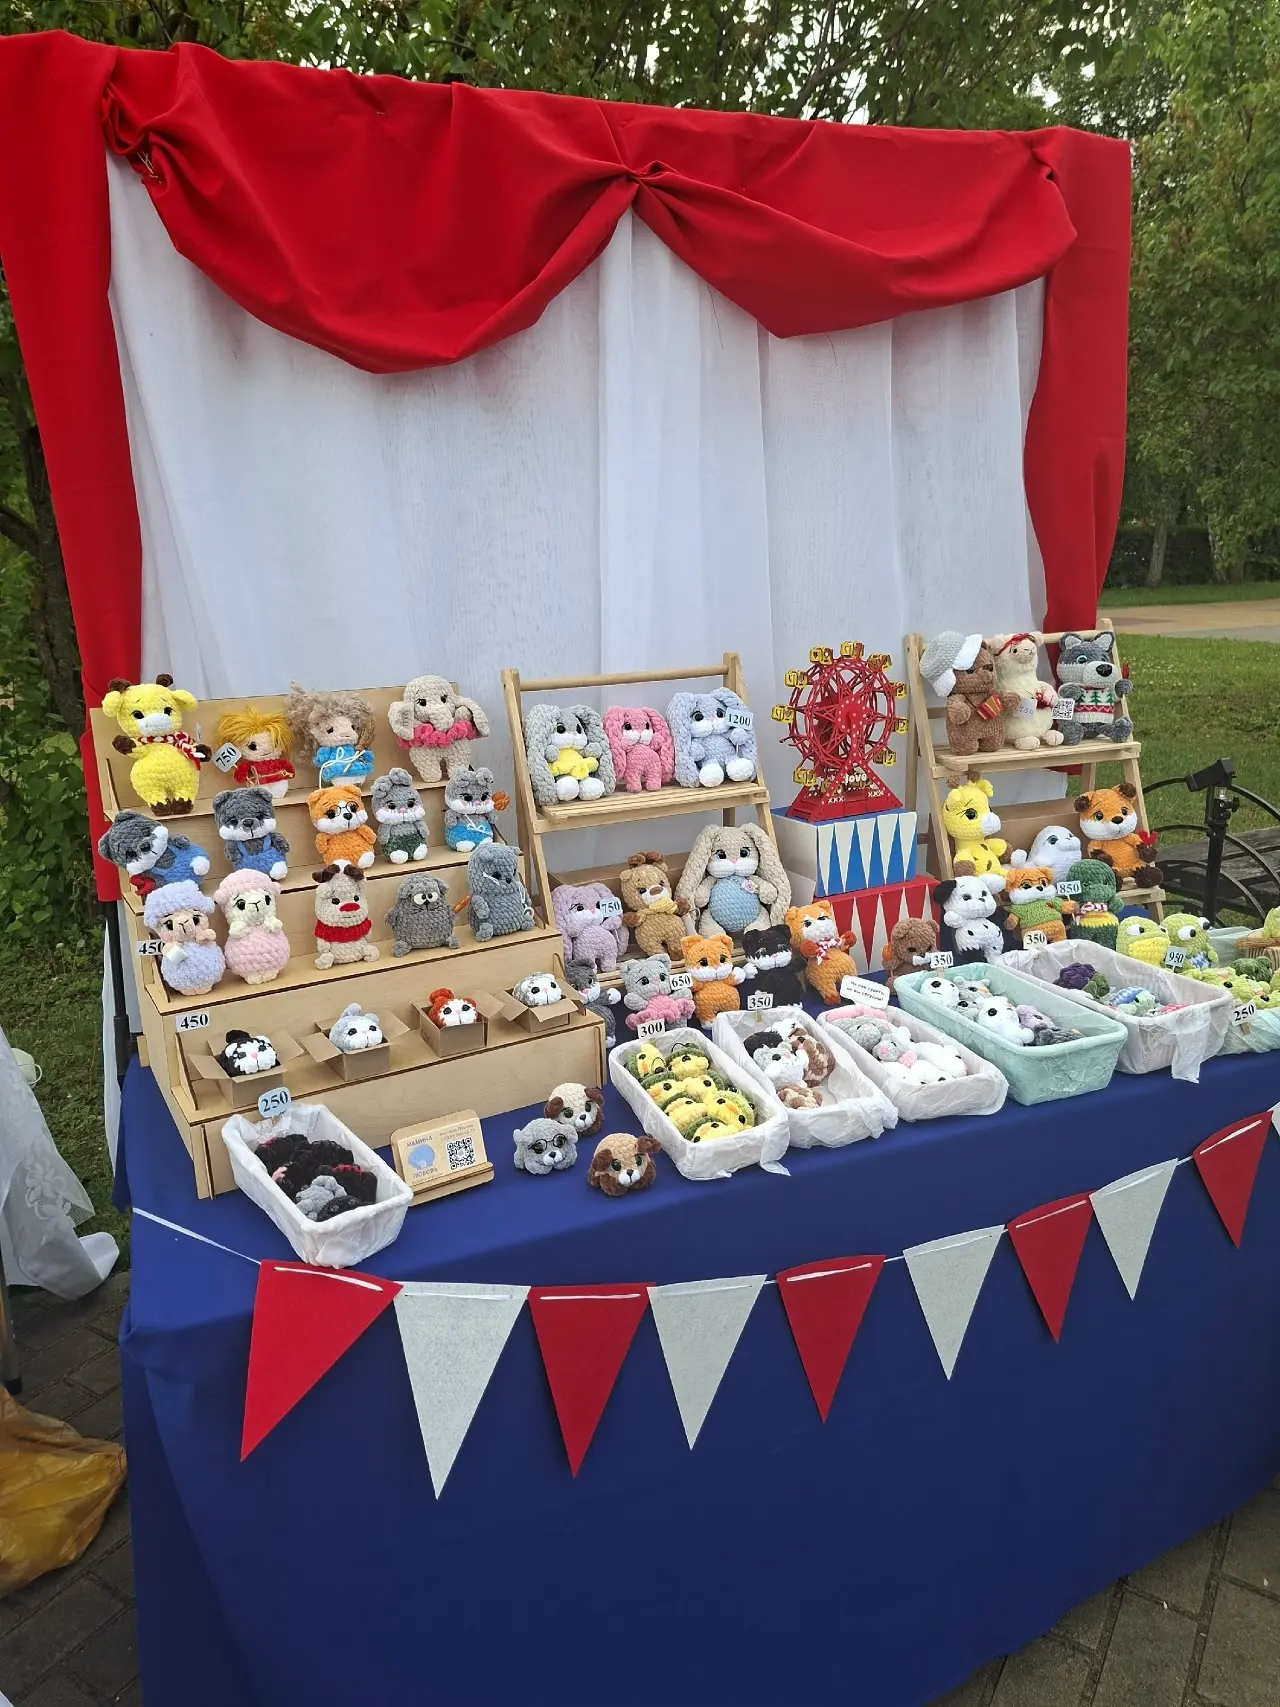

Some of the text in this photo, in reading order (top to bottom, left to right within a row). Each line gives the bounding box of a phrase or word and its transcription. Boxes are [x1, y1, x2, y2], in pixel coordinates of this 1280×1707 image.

[728, 713, 751, 727] 1200
[215, 746, 237, 767] 750
[1059, 883, 1080, 894] 850
[601, 901, 621, 914] 750
[1026, 933, 1046, 945] 350
[138, 941, 166, 955] 450
[933, 953, 952, 966] 350
[1169, 951, 1185, 964] 950
[671, 974, 691, 988] 650
[749, 996, 771, 1009] 350
[1233, 1004, 1255, 1022] 250
[180, 1014, 208, 1029] 450
[640, 1021, 663, 1038] 300
[261, 1090, 289, 1113] 250
